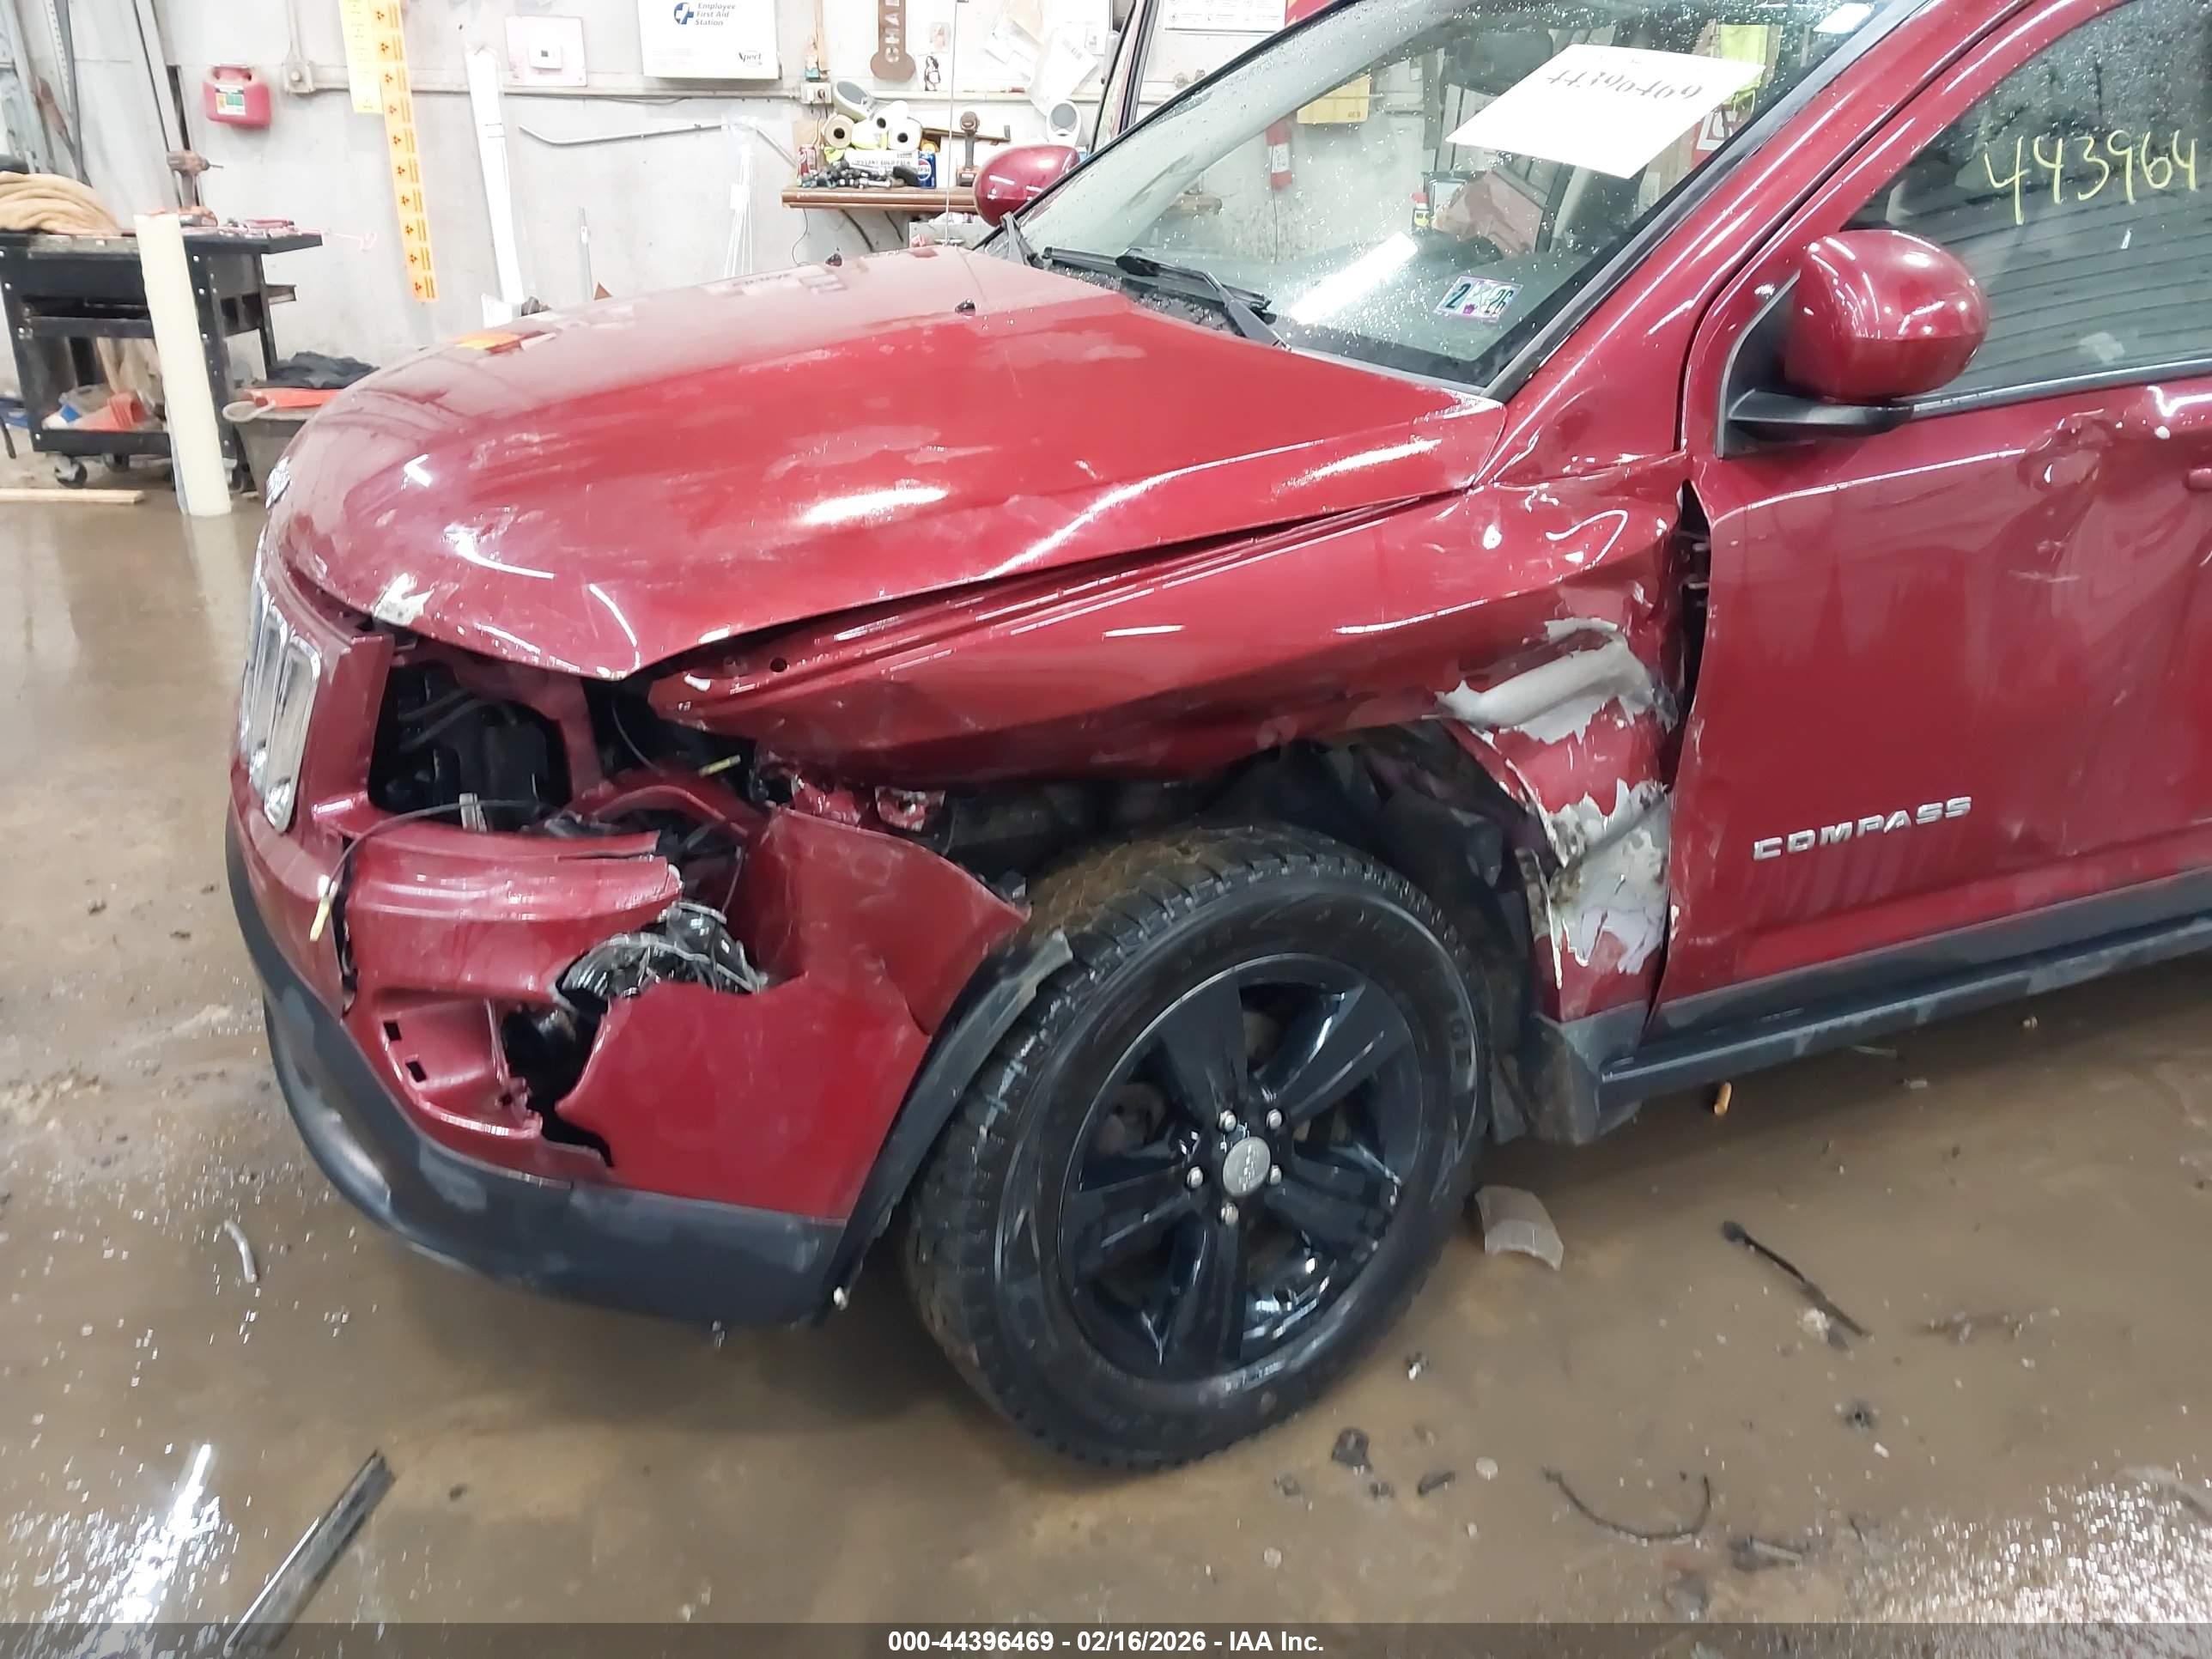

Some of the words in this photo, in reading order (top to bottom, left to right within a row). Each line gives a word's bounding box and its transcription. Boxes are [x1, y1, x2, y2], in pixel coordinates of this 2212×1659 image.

[1984, 129, 2198, 225] 443964
[1445, 283, 1472, 309] 2
[1753, 796, 1972, 860] COMPASS
